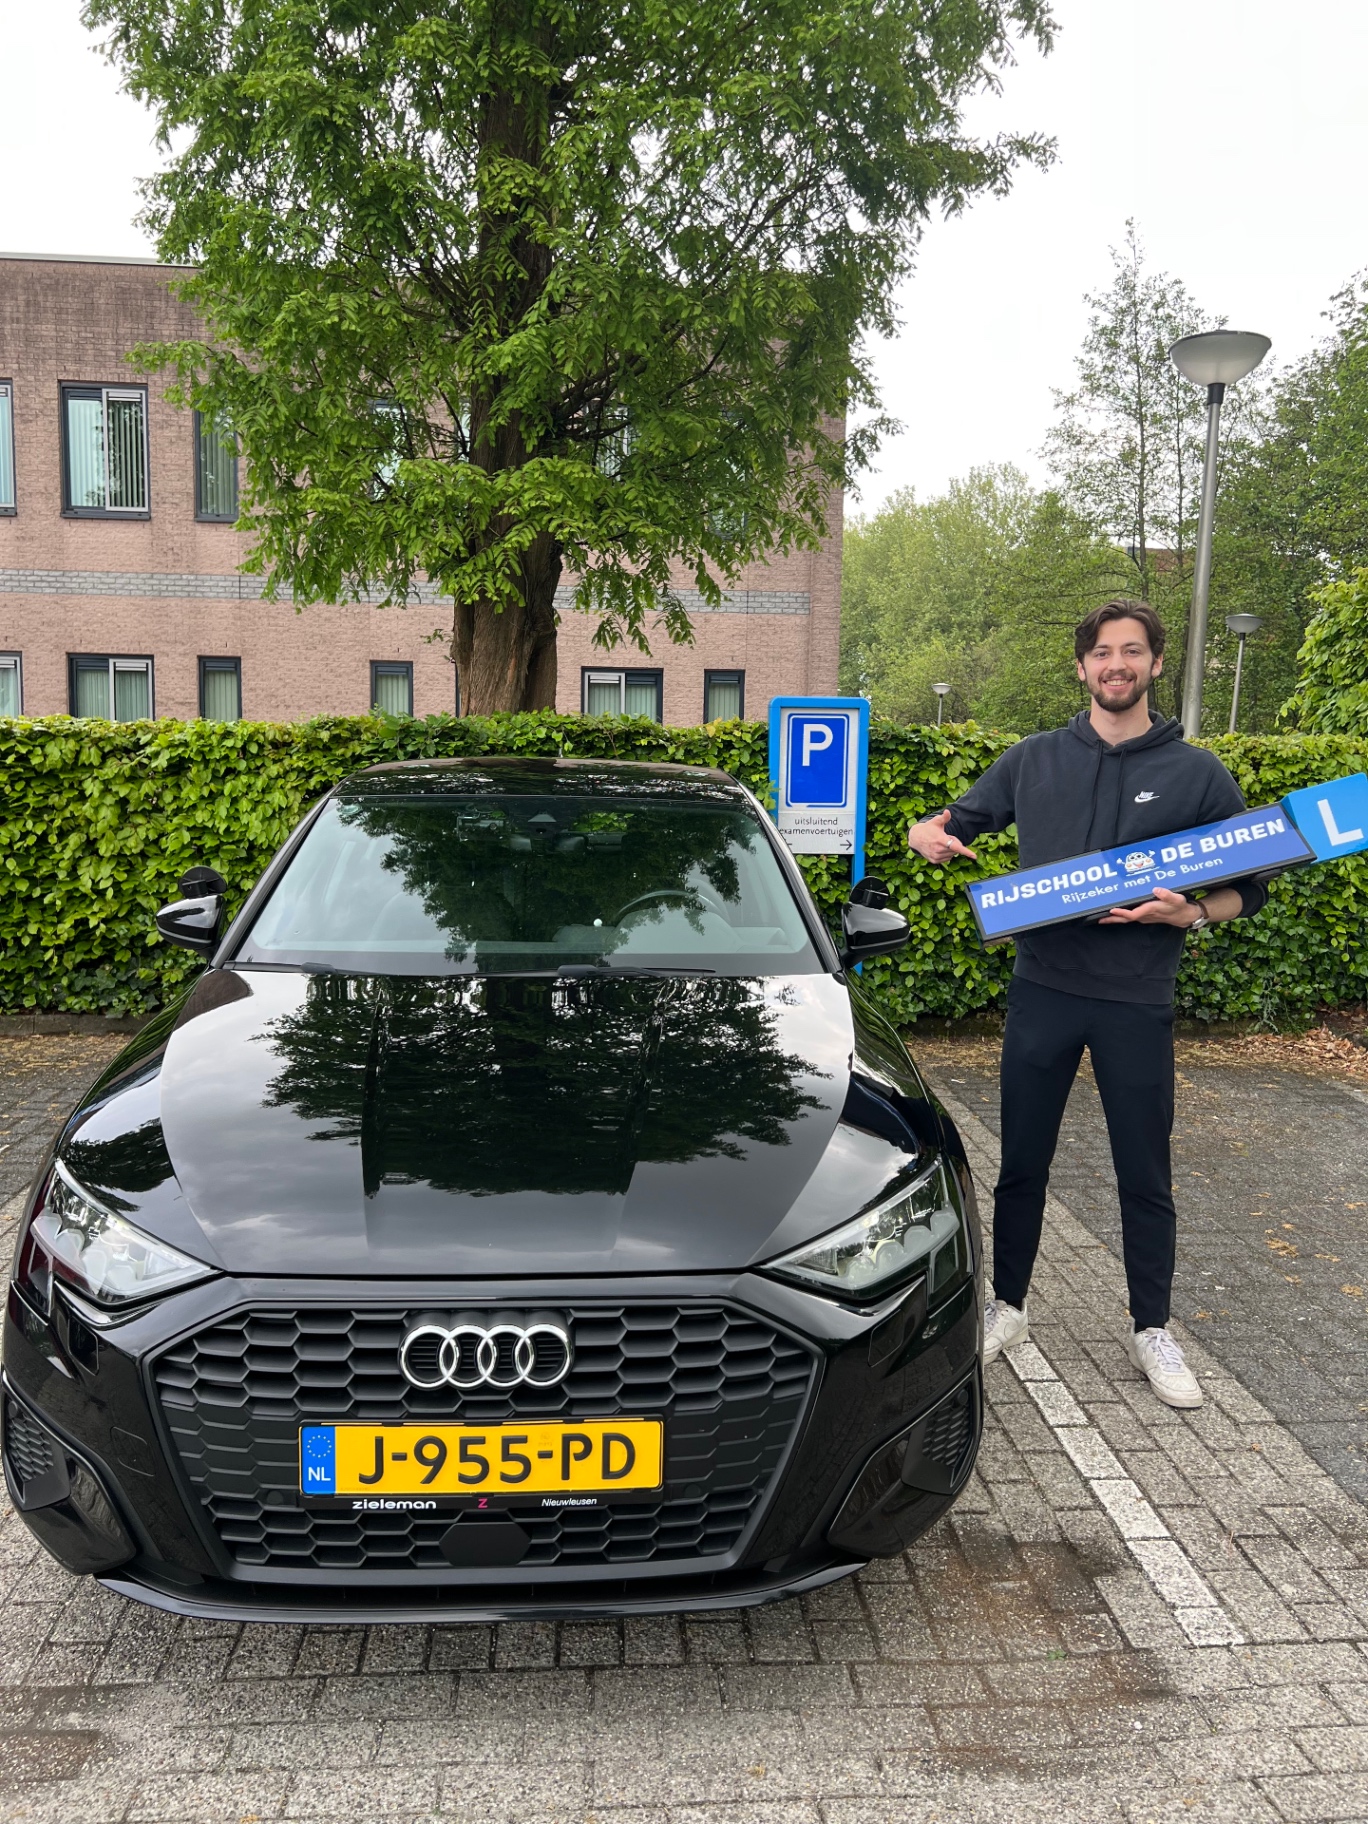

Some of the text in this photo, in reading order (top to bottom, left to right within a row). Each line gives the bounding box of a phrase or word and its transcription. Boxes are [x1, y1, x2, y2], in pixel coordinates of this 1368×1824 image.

[802, 724, 833, 766] P
[794, 816, 838, 826] uitsluitend
[1317, 799, 1364, 846] L
[981, 818, 1286, 908] RIJSCHOOL DE BUREN
[1062, 857, 1224, 904] Rijzeker met De Buren
[308, 1466, 331, 1481] NL
[358, 1433, 636, 1485] J-955-PD
[352, 1499, 437, 1510] zieleman
[541, 1498, 598, 1507] Nieuwleusen
